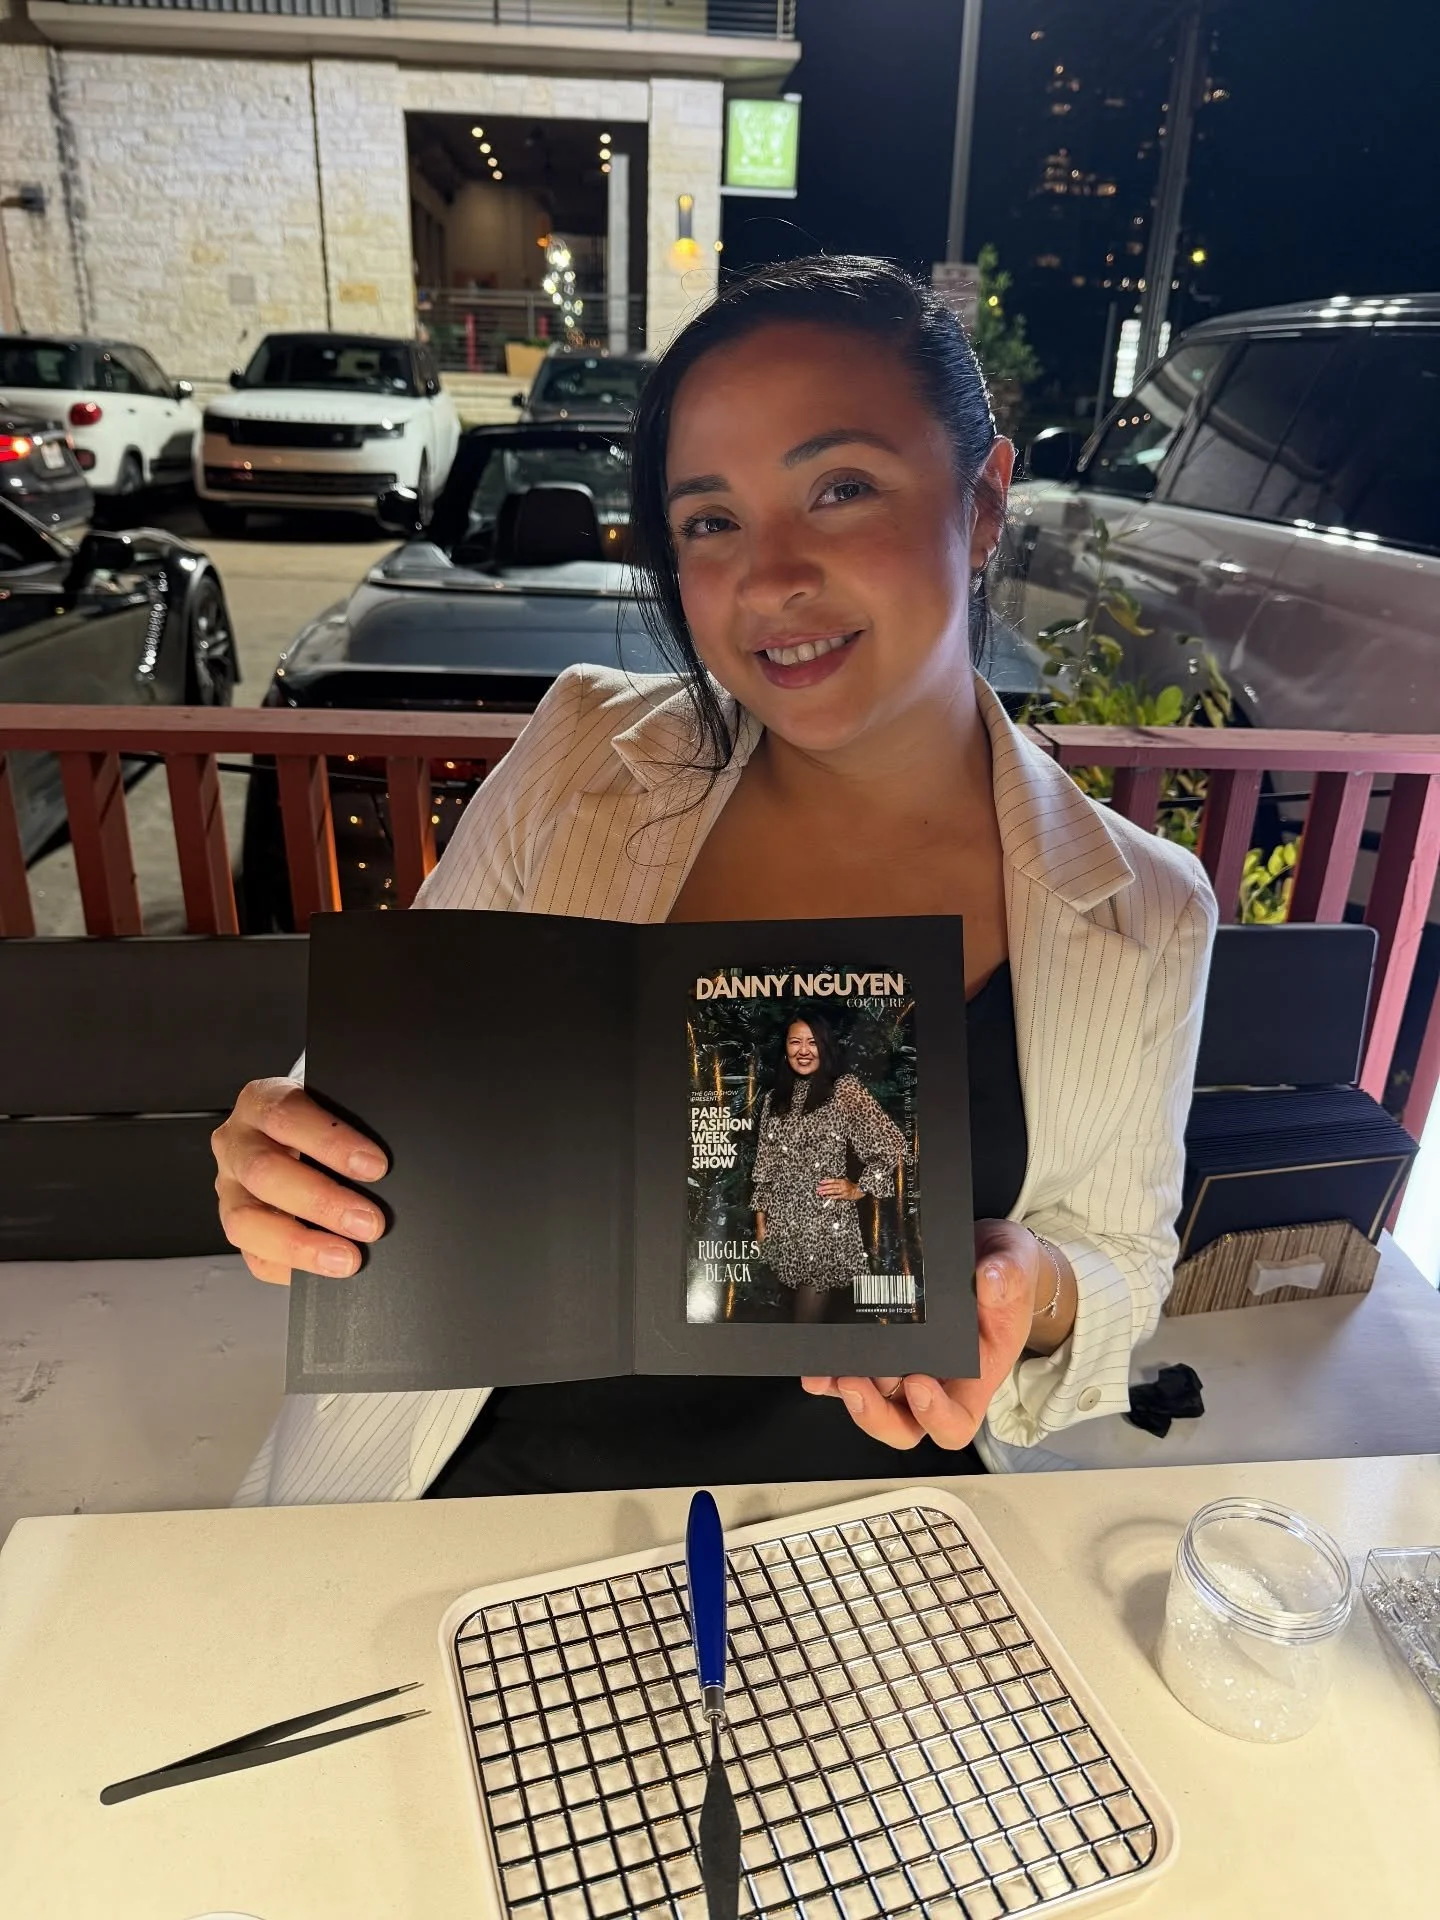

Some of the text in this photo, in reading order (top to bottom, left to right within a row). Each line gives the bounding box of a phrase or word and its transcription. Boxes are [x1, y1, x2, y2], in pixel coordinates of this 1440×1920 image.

[697, 973, 904, 1000] DANNY NGUYEN
[846, 997, 905, 1008] COUTURE
[691, 1106, 731, 1119] PARIS
[691, 1118, 752, 1132] FASHION
[691, 1131, 731, 1144] WEEK
[691, 1143, 738, 1156] TRUNK
[691, 1155, 735, 1169] SHOW
[698, 1240, 760, 1261] RUGGLES
[704, 1263, 752, 1282] BLACK
